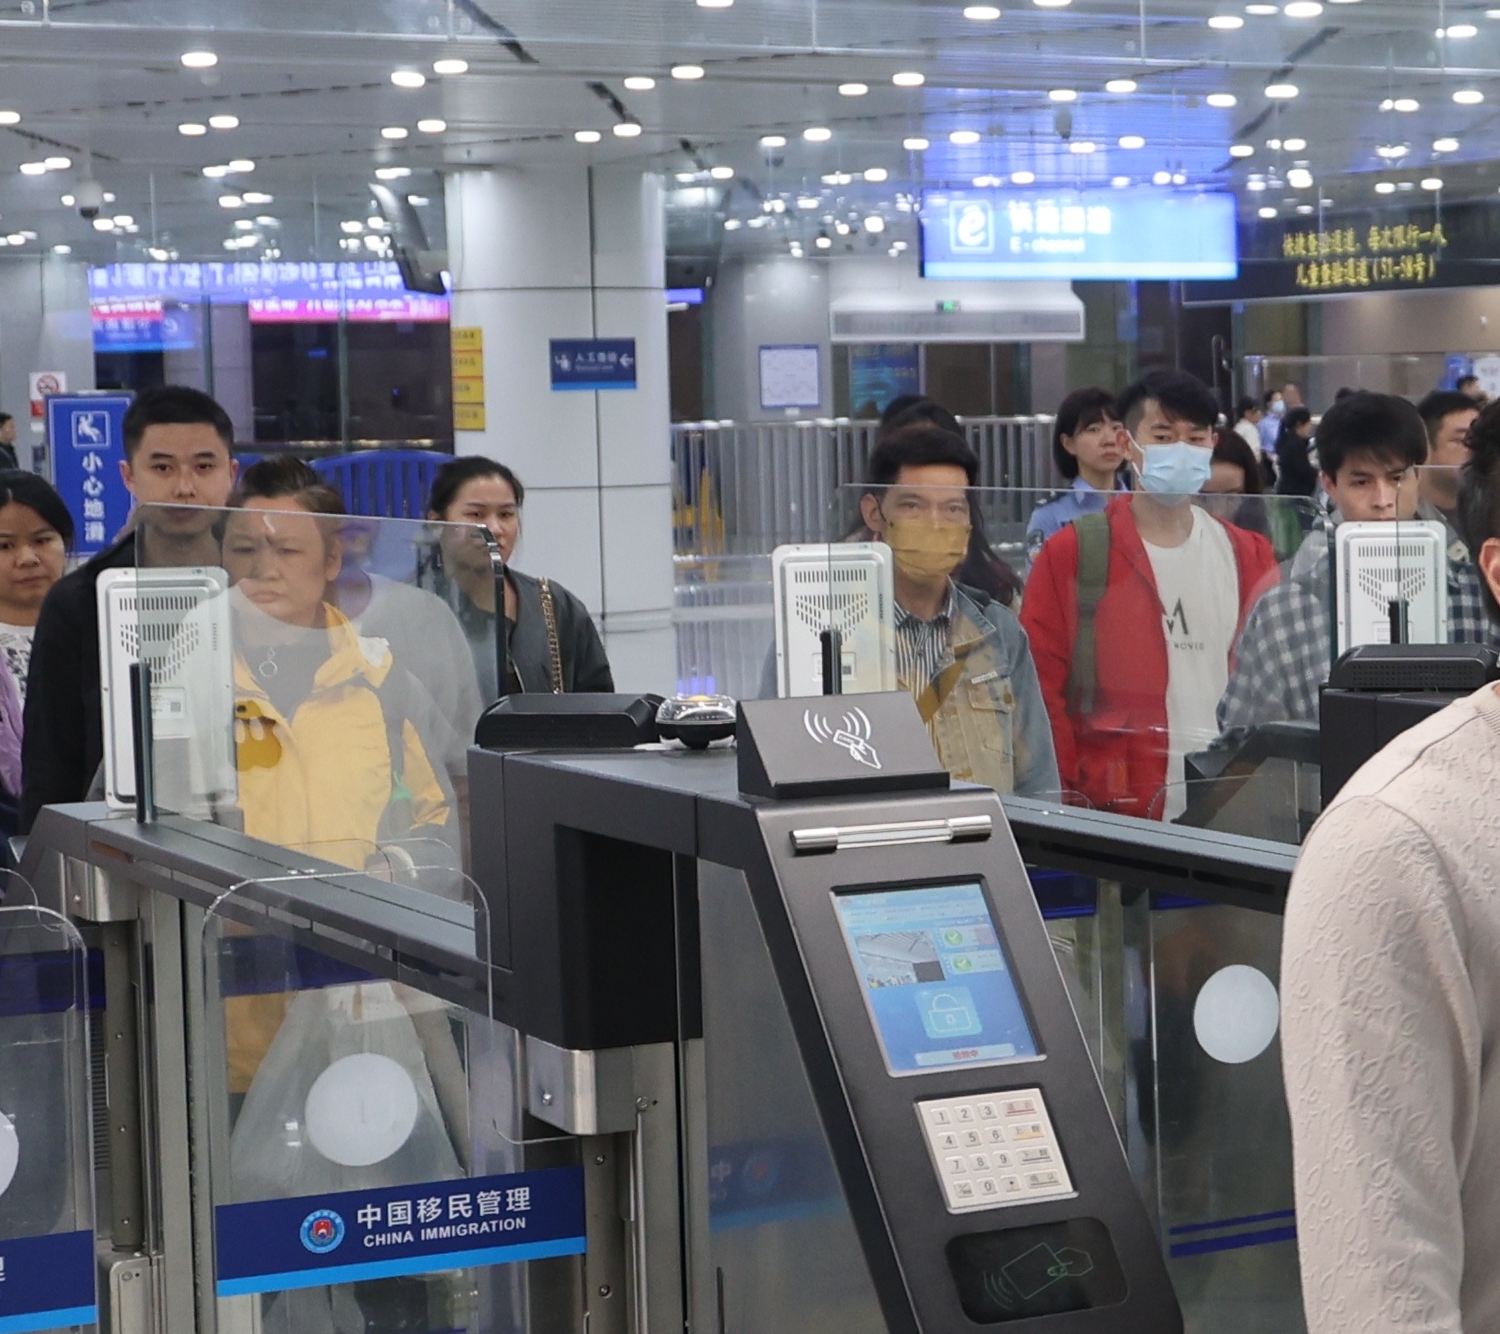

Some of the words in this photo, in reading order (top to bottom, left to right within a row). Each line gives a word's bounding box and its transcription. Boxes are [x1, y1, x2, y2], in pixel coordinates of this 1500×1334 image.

[939, 1112, 944, 1121] 1
[961, 1109, 968, 1118] 2
[984, 1106, 992, 1116] 3
[946, 1136, 953, 1145] 4
[968, 1133, 977, 1143] 5
[992, 1130, 1000, 1139] 6
[953, 1160, 960, 1169] 7
[976, 1157, 985, 1167] 8
[1000, 1154, 1007, 1164] 9
[984, 1181, 992, 1191] 0
[357, 1187, 531, 1230] 中国移民管理
[363, 1232, 414, 1248] CHINA
[421, 1217, 526, 1241] IMMIGRATION
